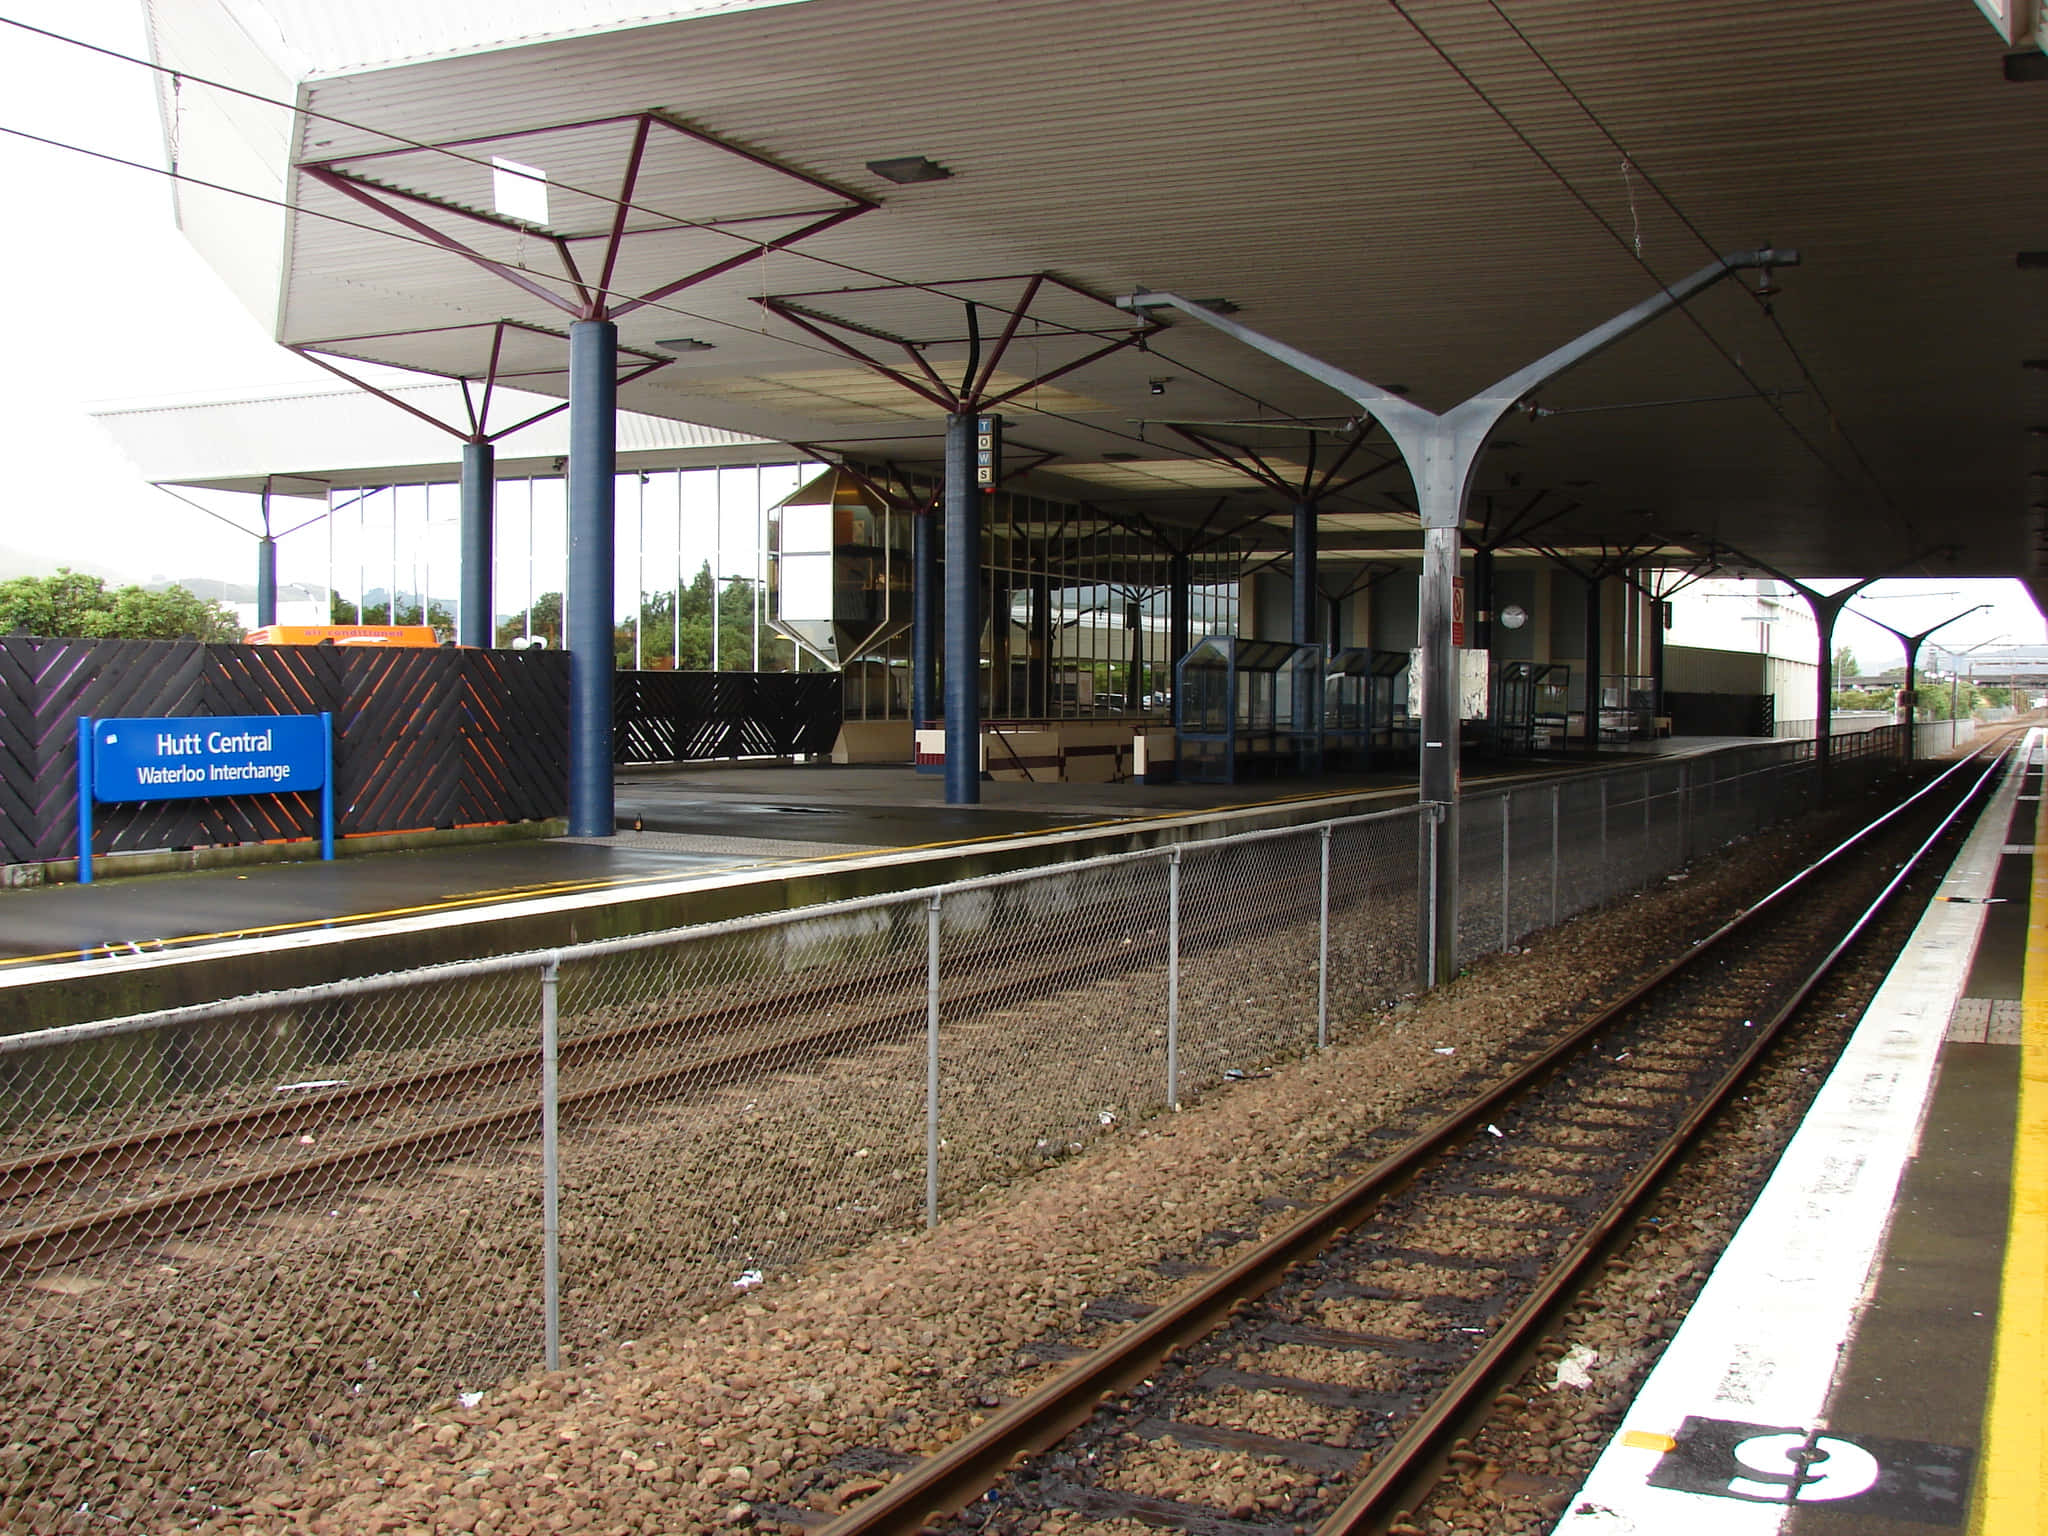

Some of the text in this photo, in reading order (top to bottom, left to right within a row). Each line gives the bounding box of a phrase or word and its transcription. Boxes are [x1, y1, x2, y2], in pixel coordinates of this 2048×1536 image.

[157, 728, 272, 756] Hutt Central
[137, 761, 291, 785] Waterloo Interchange
